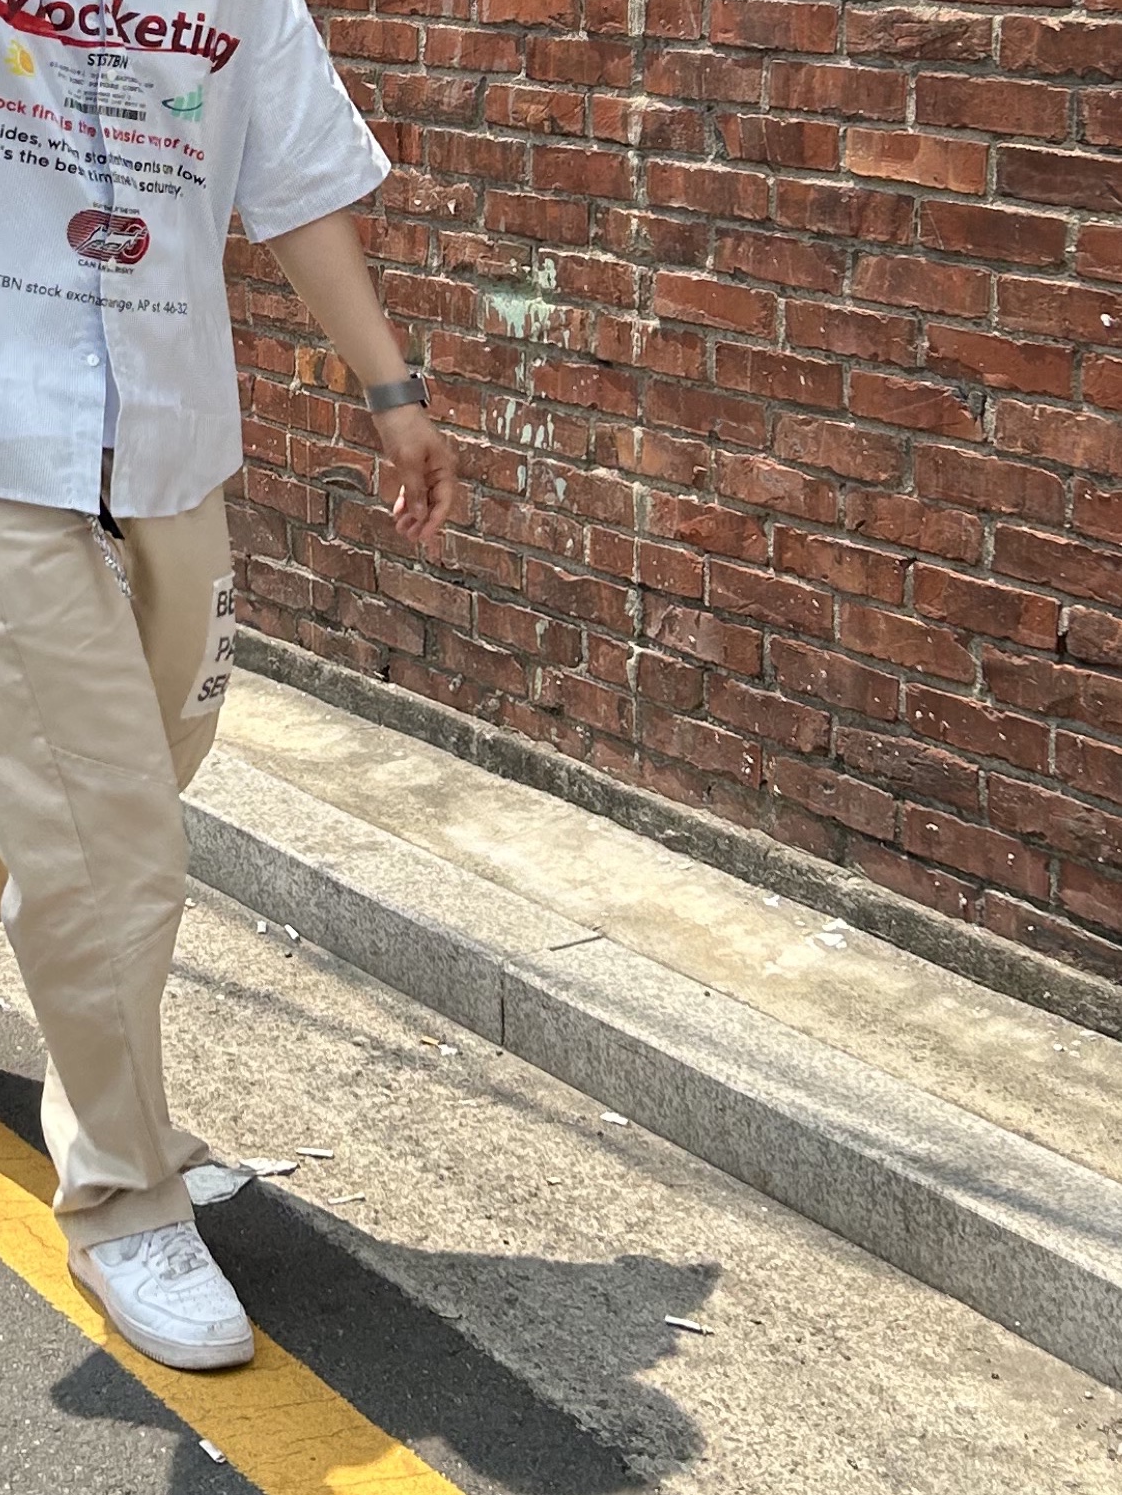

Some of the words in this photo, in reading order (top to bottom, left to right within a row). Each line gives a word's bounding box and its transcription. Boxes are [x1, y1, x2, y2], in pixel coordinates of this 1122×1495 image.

[19, 149, 50, 168] the
[177, 164, 207, 190] low,
[25, 280, 62, 300] stock
